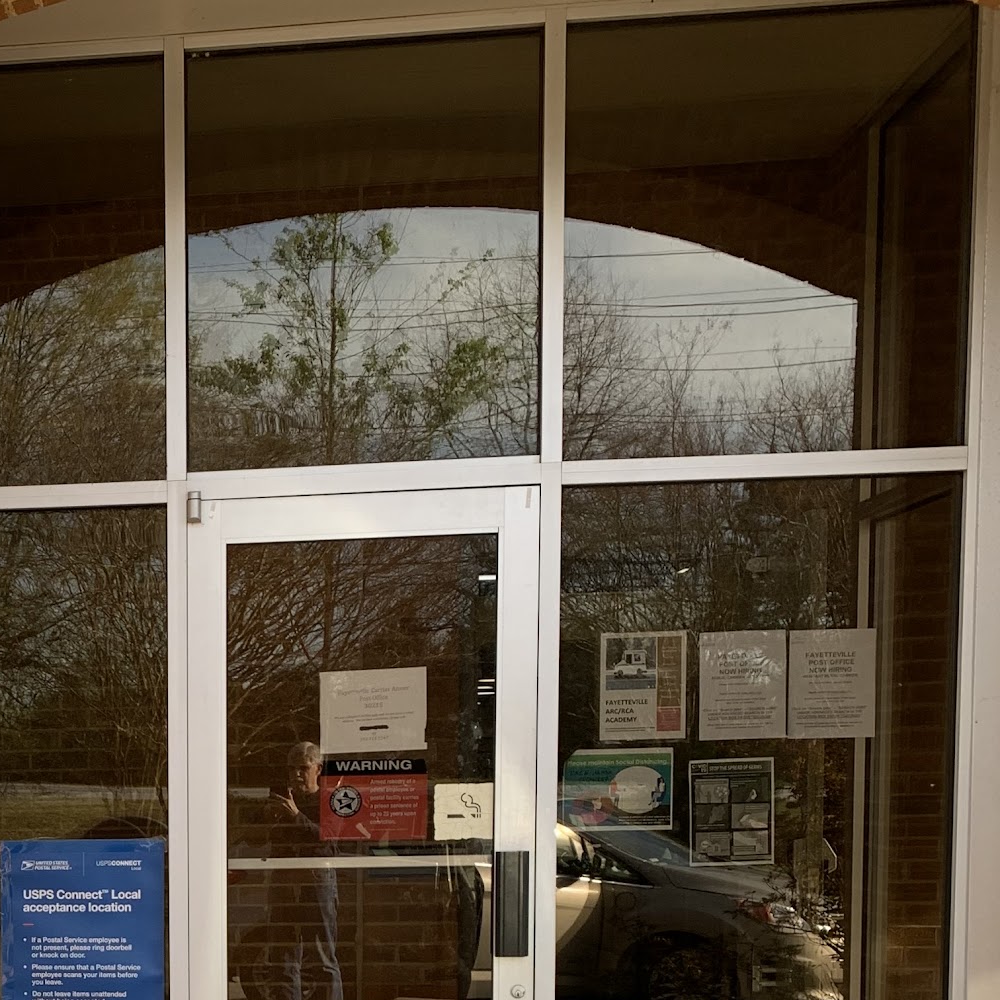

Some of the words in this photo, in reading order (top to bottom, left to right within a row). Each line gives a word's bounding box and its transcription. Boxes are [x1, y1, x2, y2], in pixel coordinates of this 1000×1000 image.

[605, 698, 648, 706] FAYETTEVILLE
[336, 760, 412, 771] WARNING
[22, 889, 54, 900] USPS
[111, 889, 142, 900] Local
[22, 902, 86, 914] acceptance
[88, 902, 132, 912] location
